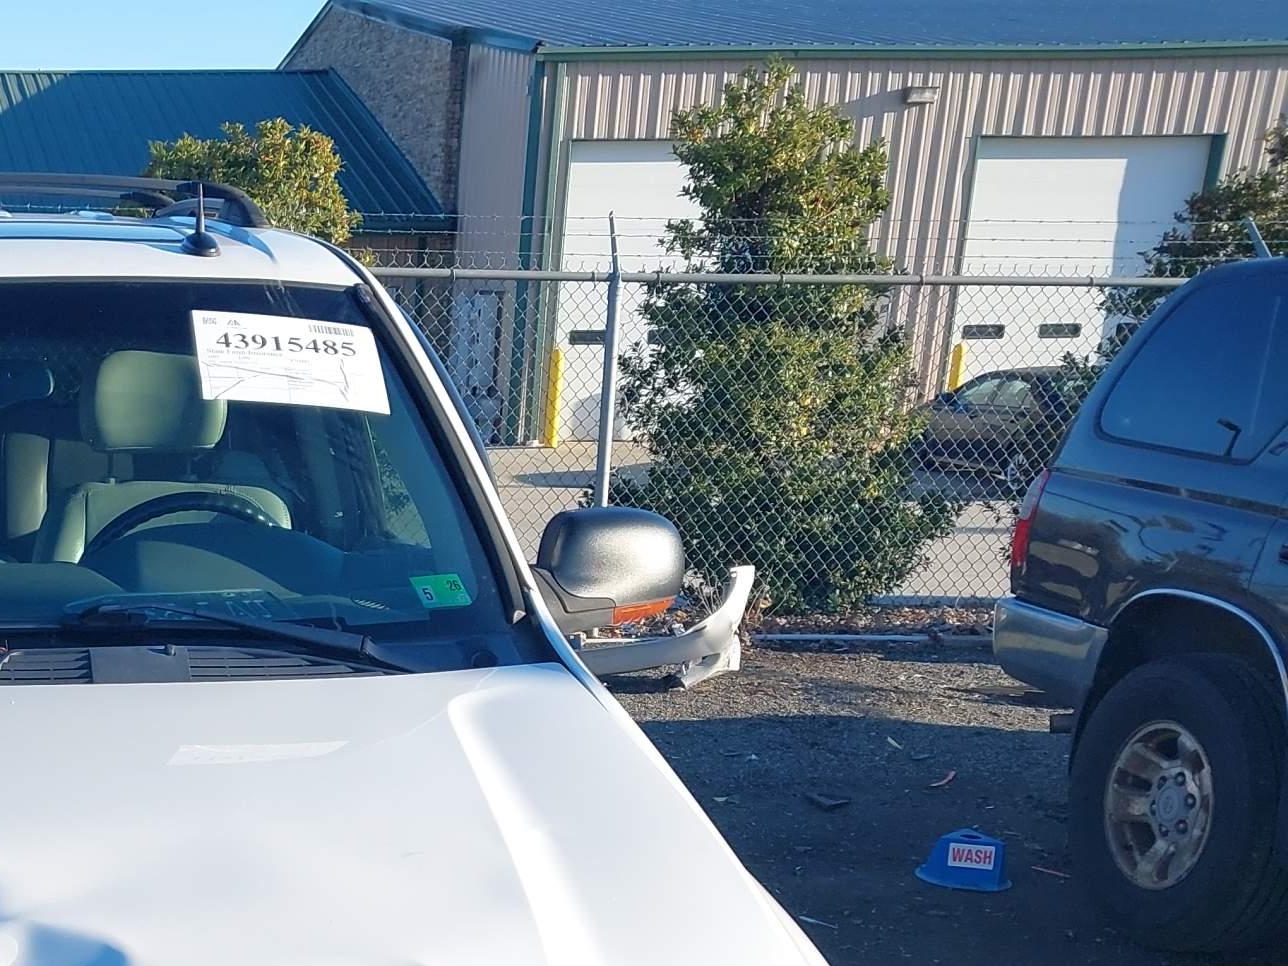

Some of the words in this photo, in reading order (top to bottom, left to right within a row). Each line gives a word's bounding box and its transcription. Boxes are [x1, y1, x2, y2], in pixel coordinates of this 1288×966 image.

[216, 331, 357, 357] 43915485
[421, 587, 434, 601] 5
[951, 847, 993, 865] WASH
